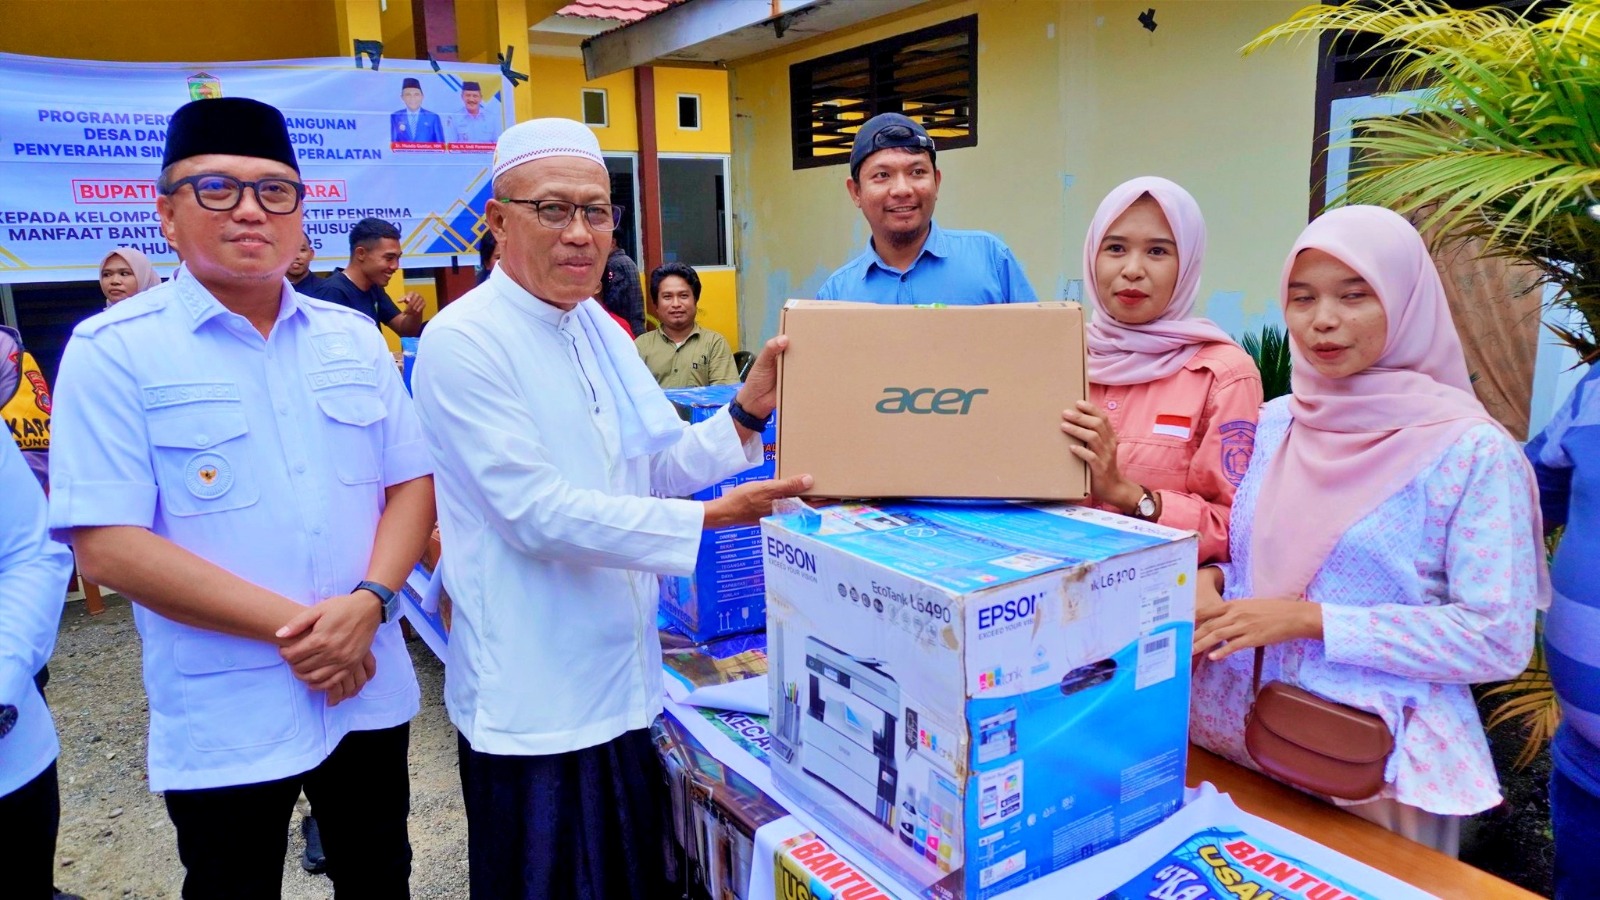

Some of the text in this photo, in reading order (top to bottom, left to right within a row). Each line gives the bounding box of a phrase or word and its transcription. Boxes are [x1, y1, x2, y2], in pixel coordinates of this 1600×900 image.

[38, 109, 130, 125] PROGRAM
[84, 128, 131, 141] DESA
[14, 143, 138, 158] PENYERAHAN
[298, 148, 382, 160] PERALATAN
[80, 184, 157, 199] BUPATI
[337, 207, 412, 219] PENERIMA
[9, 227, 103, 241] MANFAAT
[875, 387, 989, 415] acer
[766, 535, 817, 575] EPSON
[871, 580, 908, 607] EcoTank
[909, 593, 951, 624] L6490
